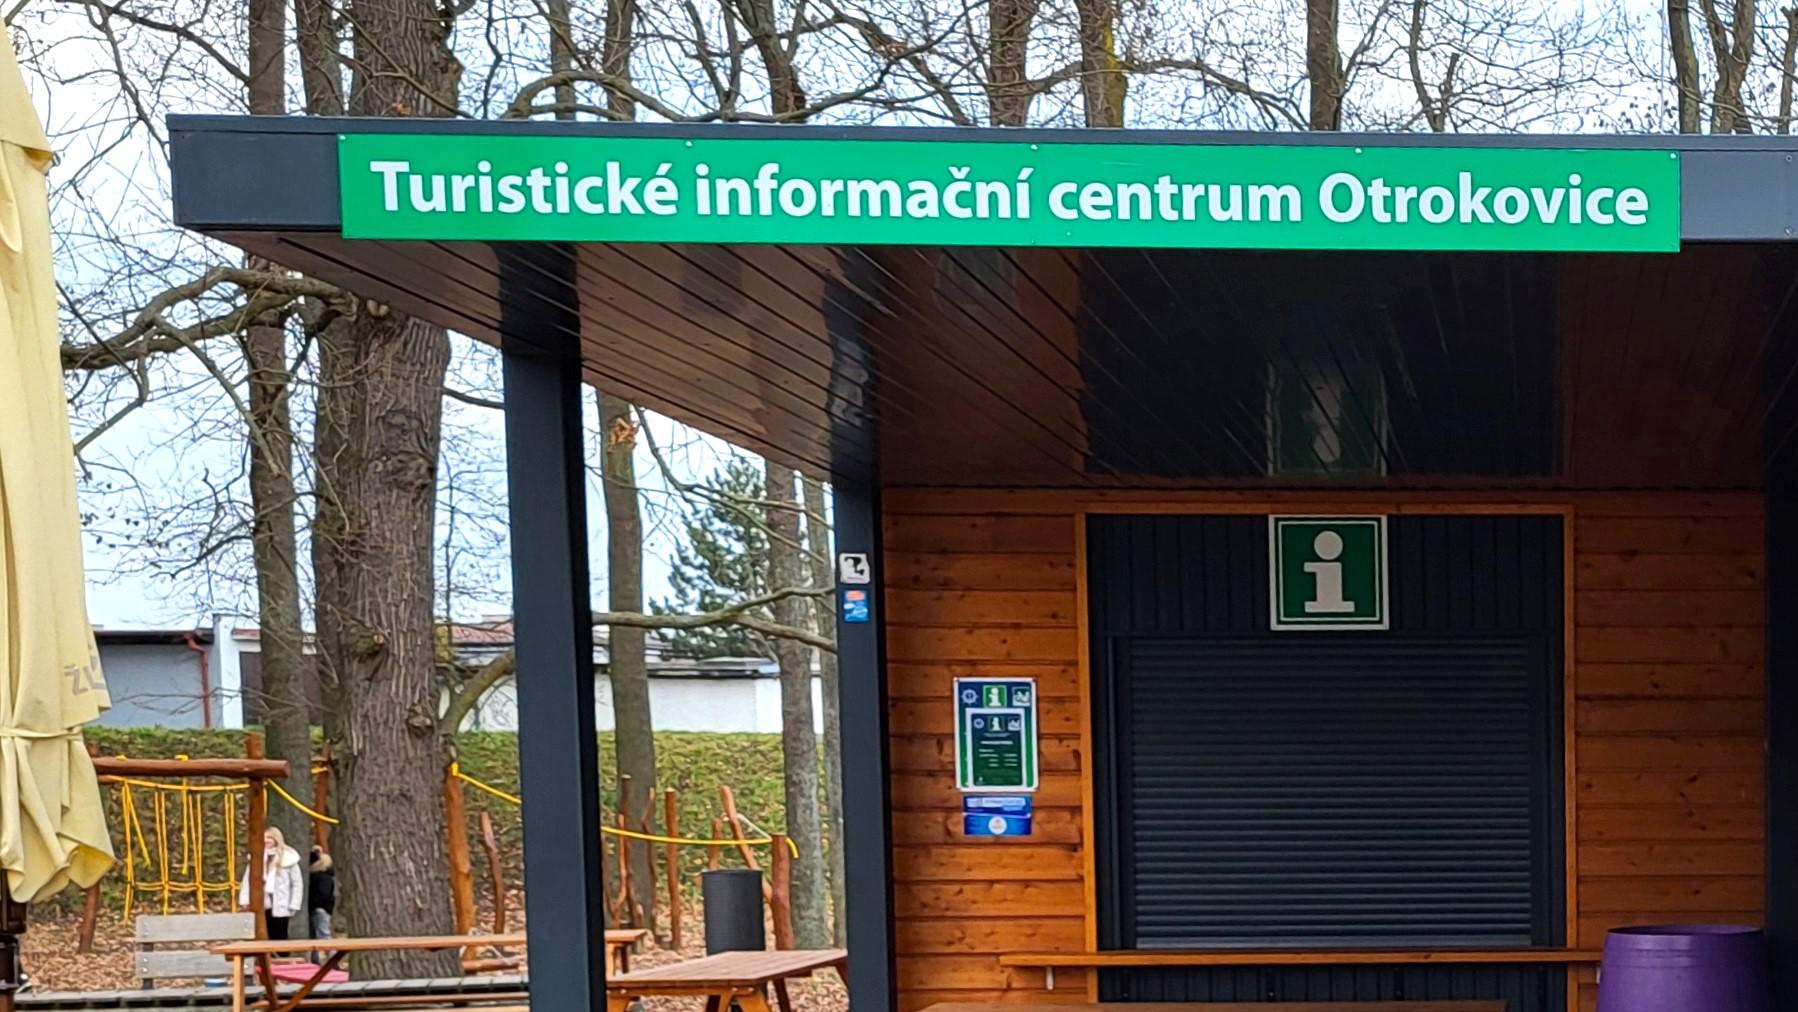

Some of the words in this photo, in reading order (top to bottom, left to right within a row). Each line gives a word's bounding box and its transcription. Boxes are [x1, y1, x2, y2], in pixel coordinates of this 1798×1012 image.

[370, 160, 678, 215] Turistické
[695, 163, 1034, 219] informační
[1048, 175, 1301, 221] centrum
[1319, 172, 1649, 225] Otrokovice
